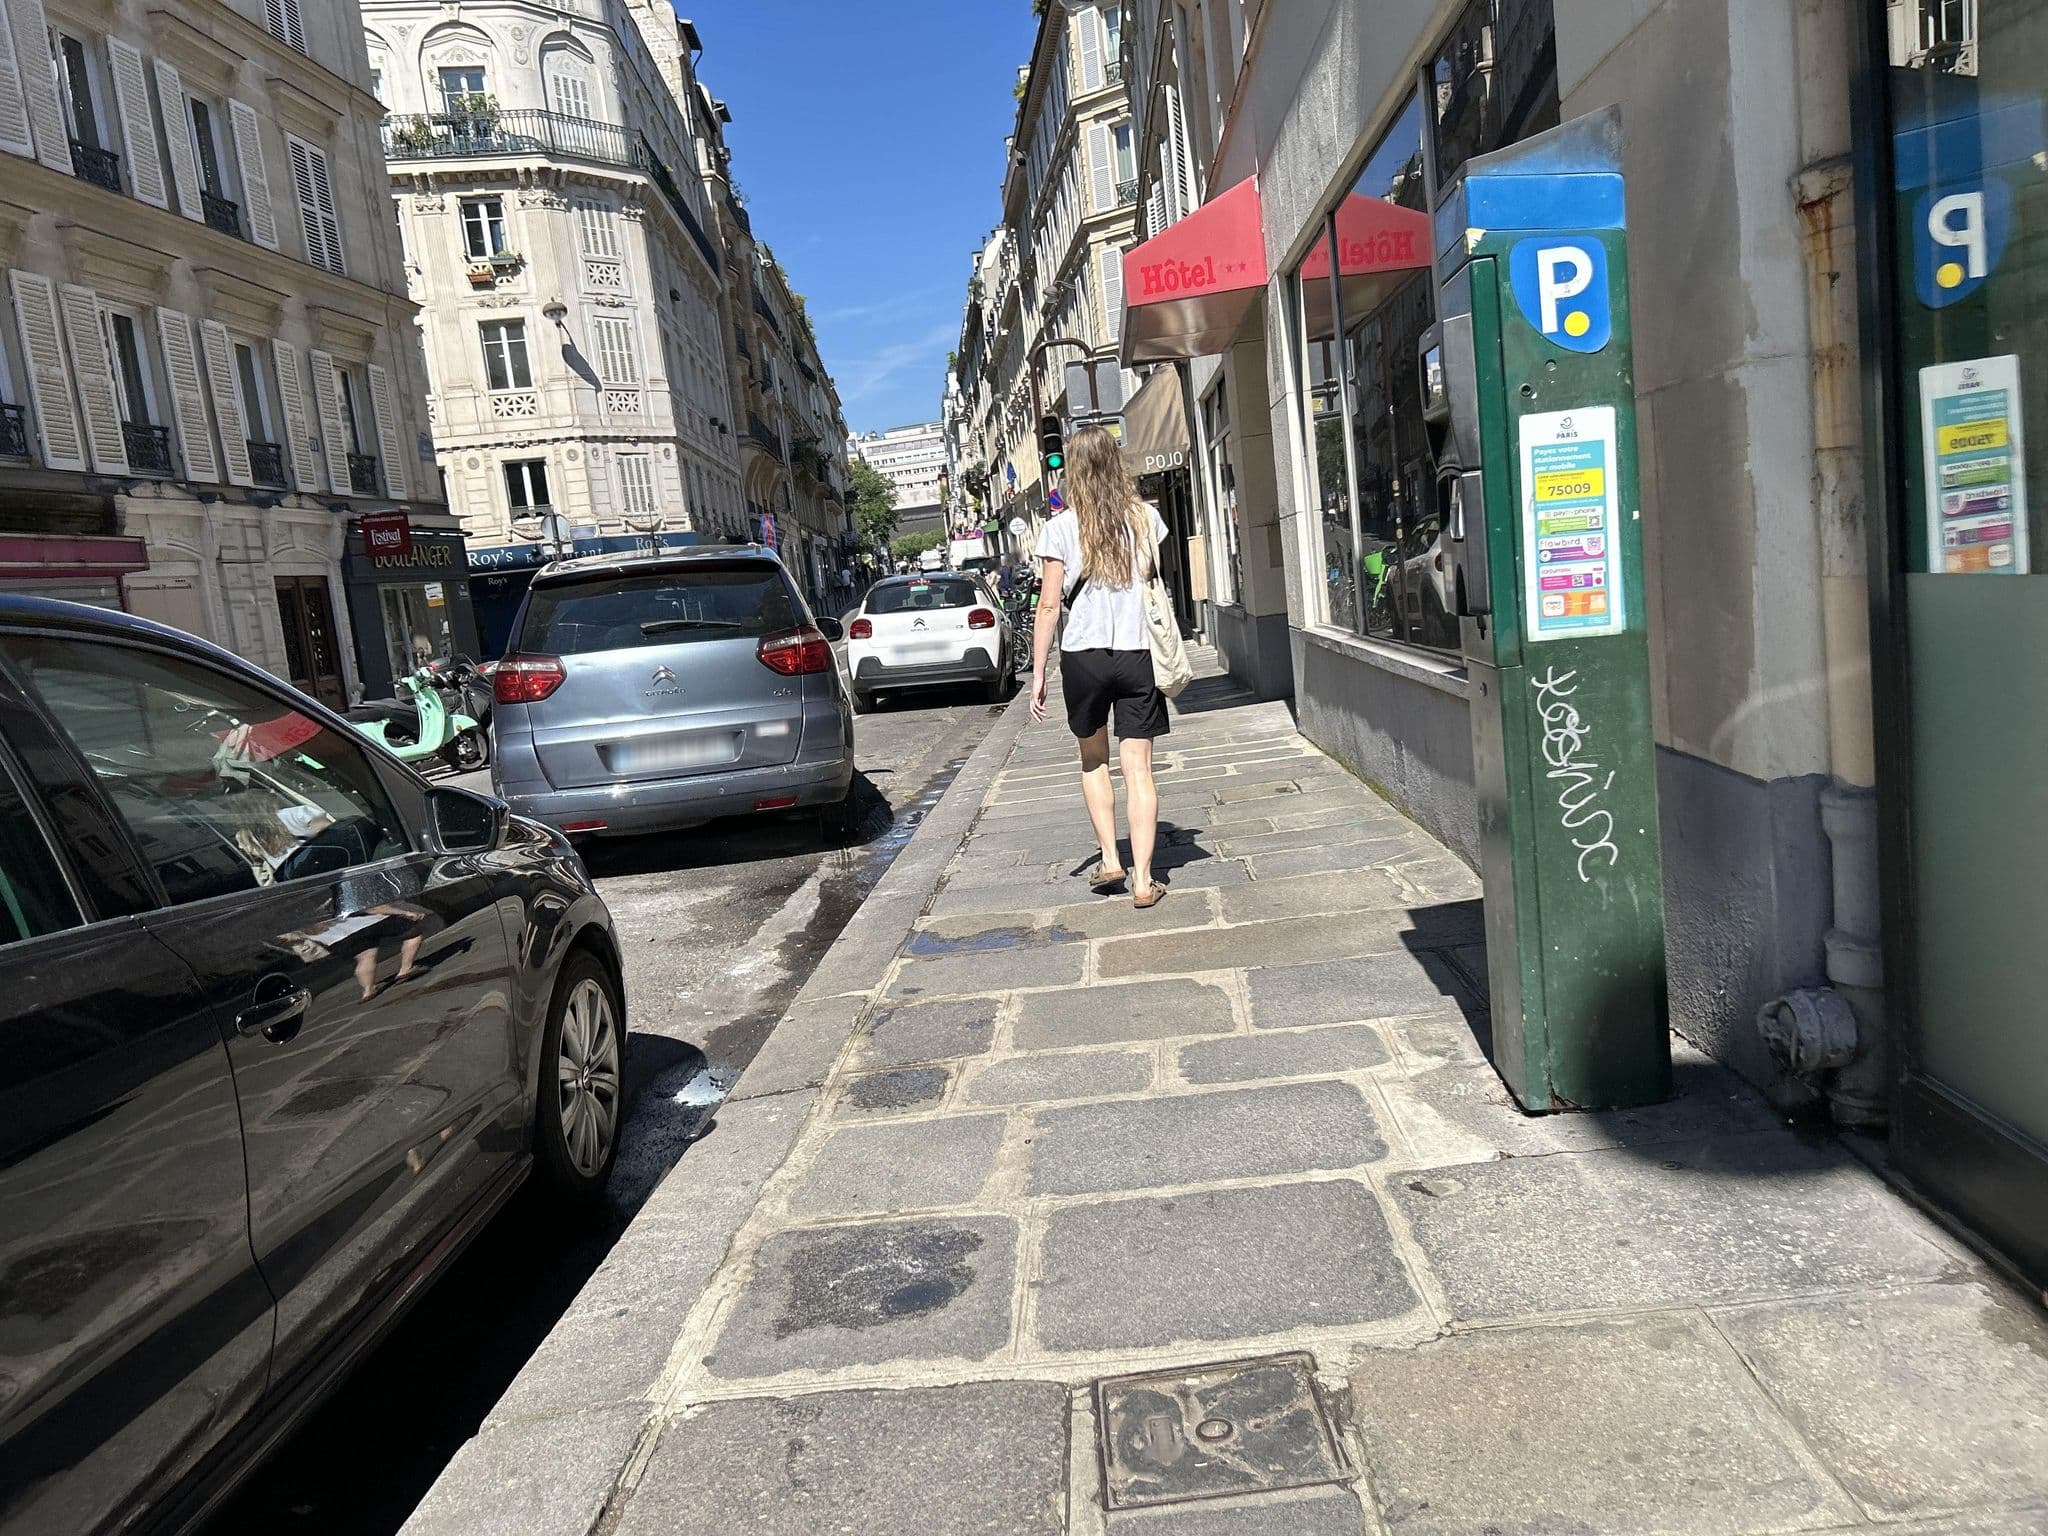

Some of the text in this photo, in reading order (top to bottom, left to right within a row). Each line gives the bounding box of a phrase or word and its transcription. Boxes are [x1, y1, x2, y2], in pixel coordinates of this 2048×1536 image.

[1140, 255, 1217, 295] Hôtel
[1537, 246, 1594, 334] P
[1556, 431, 1579, 439] PARIS
[1145, 451, 1184, 471] POJO
[1548, 483, 1591, 496] 75009
[370, 528, 401, 545] Festival
[466, 549, 513, 567] Roy's
